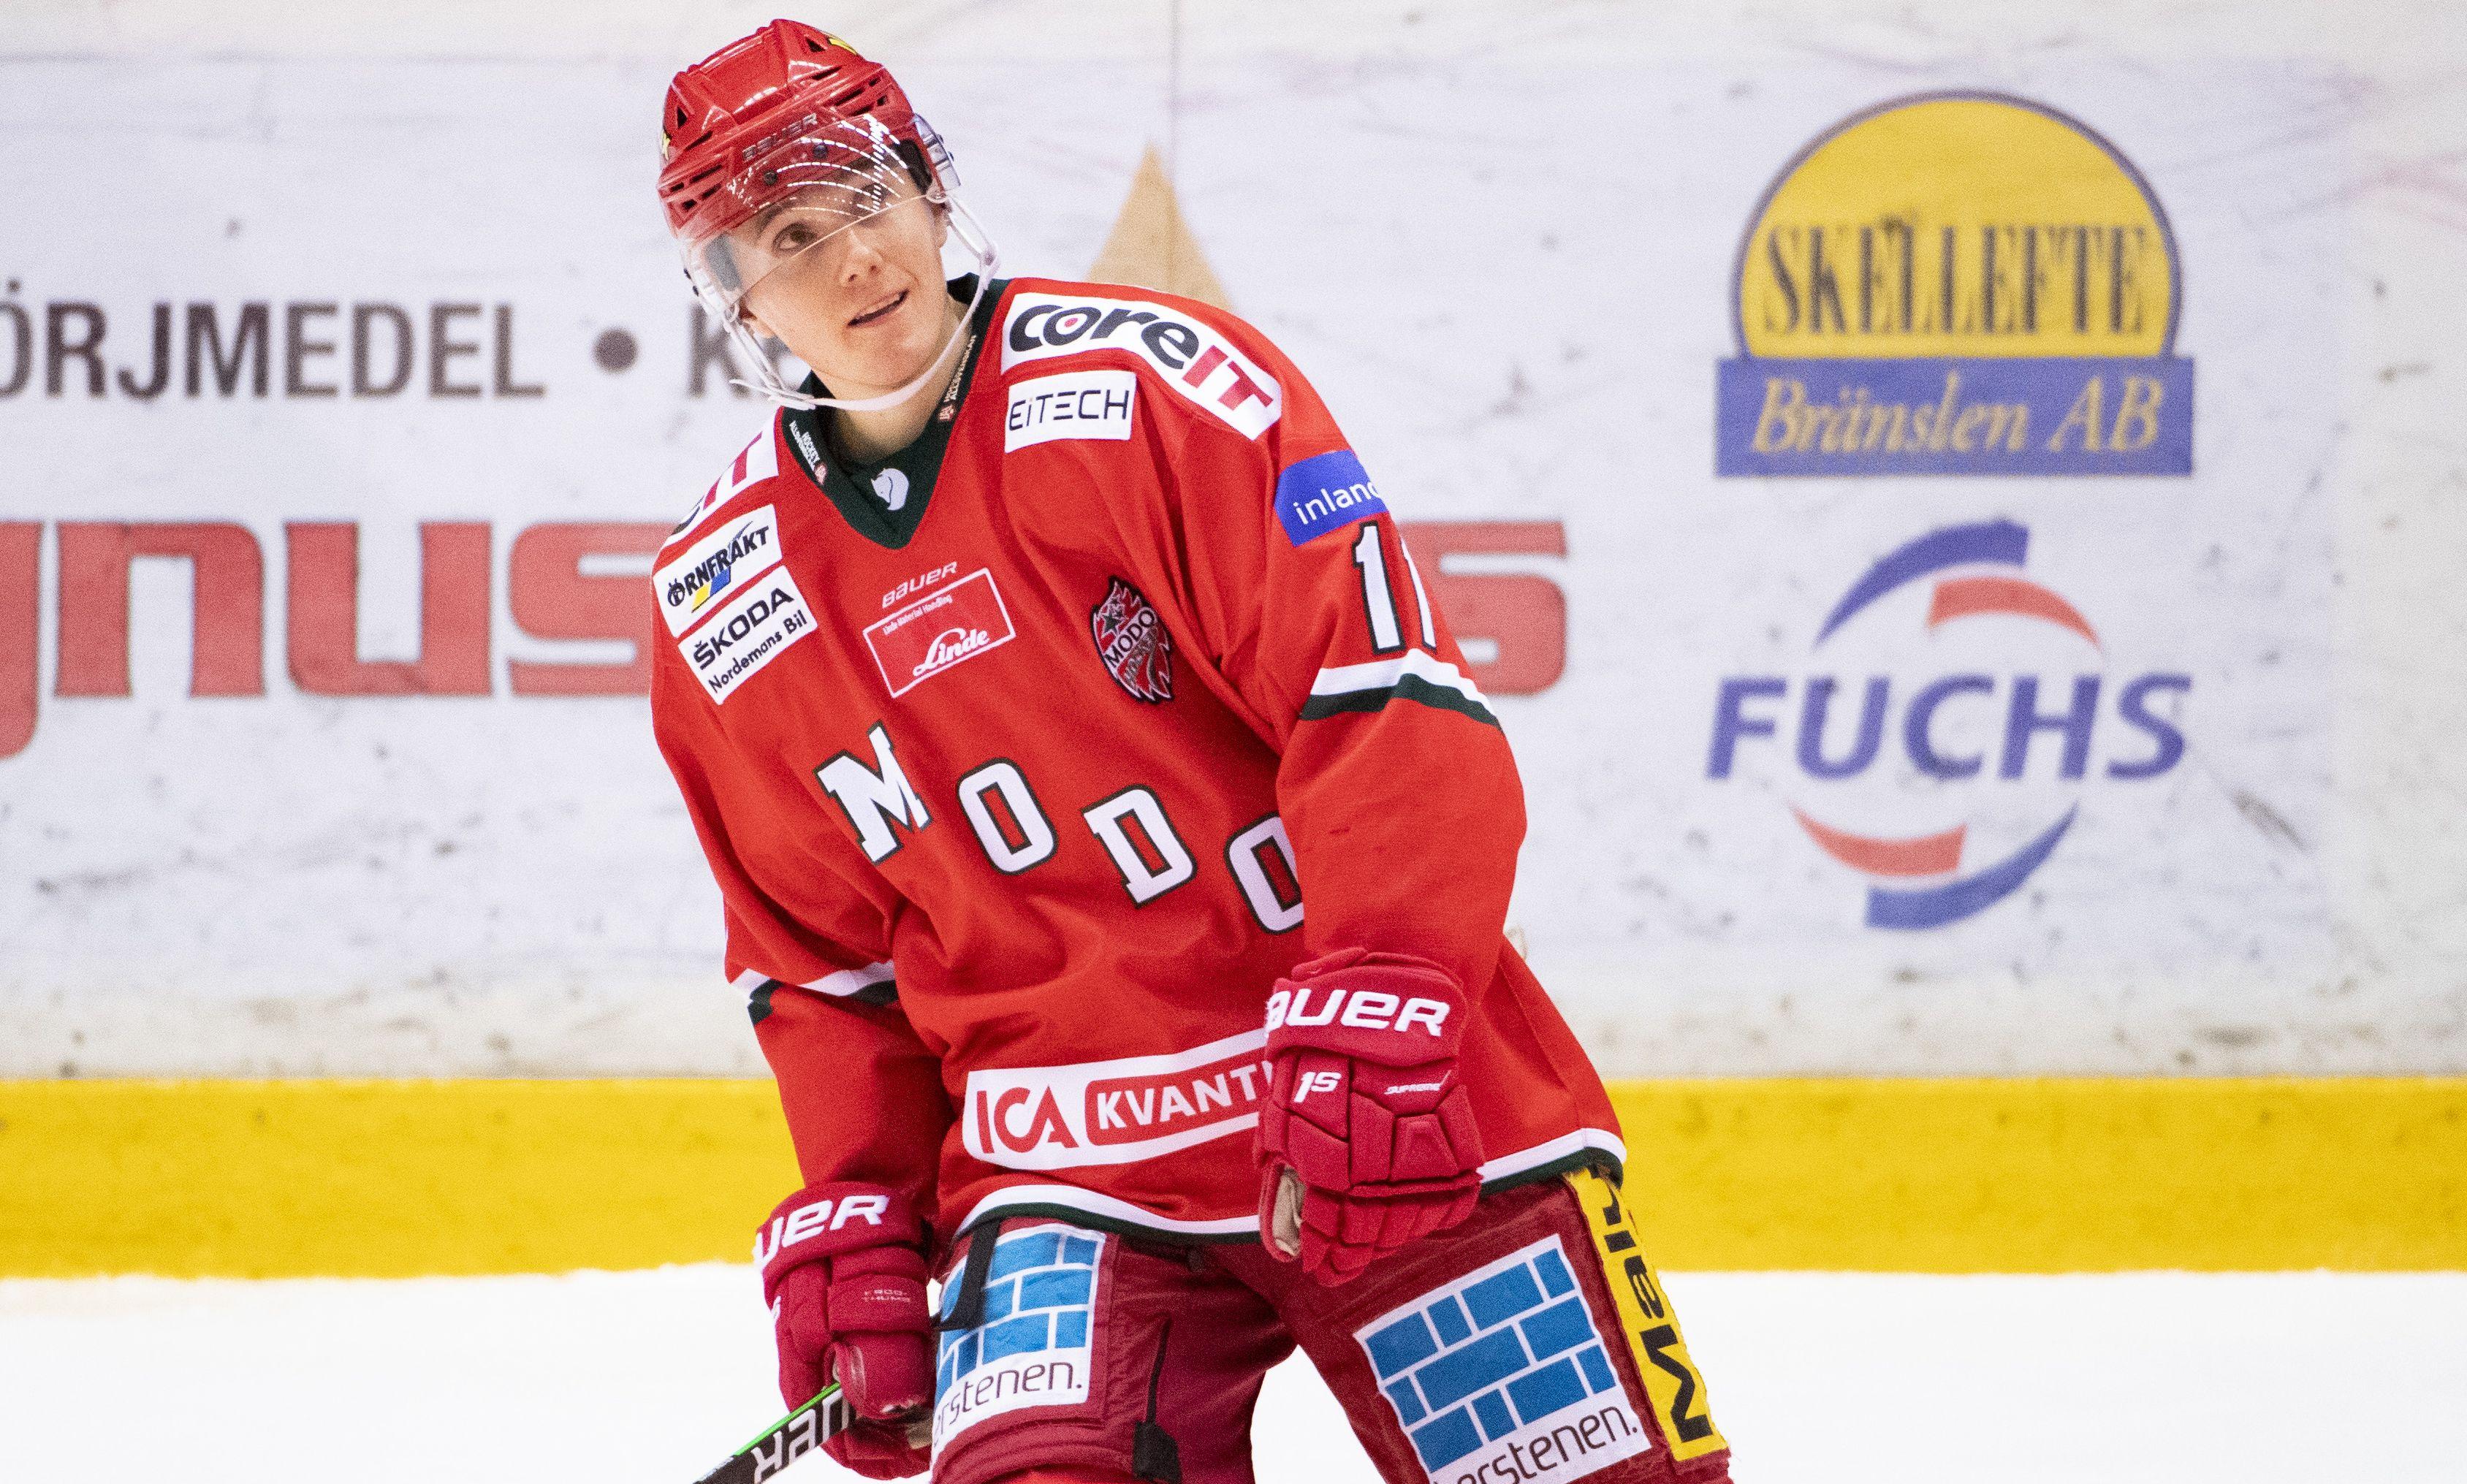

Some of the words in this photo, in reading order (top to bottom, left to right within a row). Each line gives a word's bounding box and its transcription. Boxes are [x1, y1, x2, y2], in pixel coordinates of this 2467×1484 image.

[1764, 224, 2147, 335] SKELLEFTE
[1754, 370, 2031, 454] Bränslen
[2050, 376, 2165, 454] AB
[693, 587, 794, 670] ŠKODA
[708, 631, 783, 693] Nordemans
[783, 609, 807, 635] Bil
[912, 628, 991, 677] Linde
[1105, 609, 1155, 668] MODO
[1705, 673, 2193, 781] FUCHS
[976, 1084, 1078, 1154] ICA
[1097, 1060, 1273, 1132] KVANT
